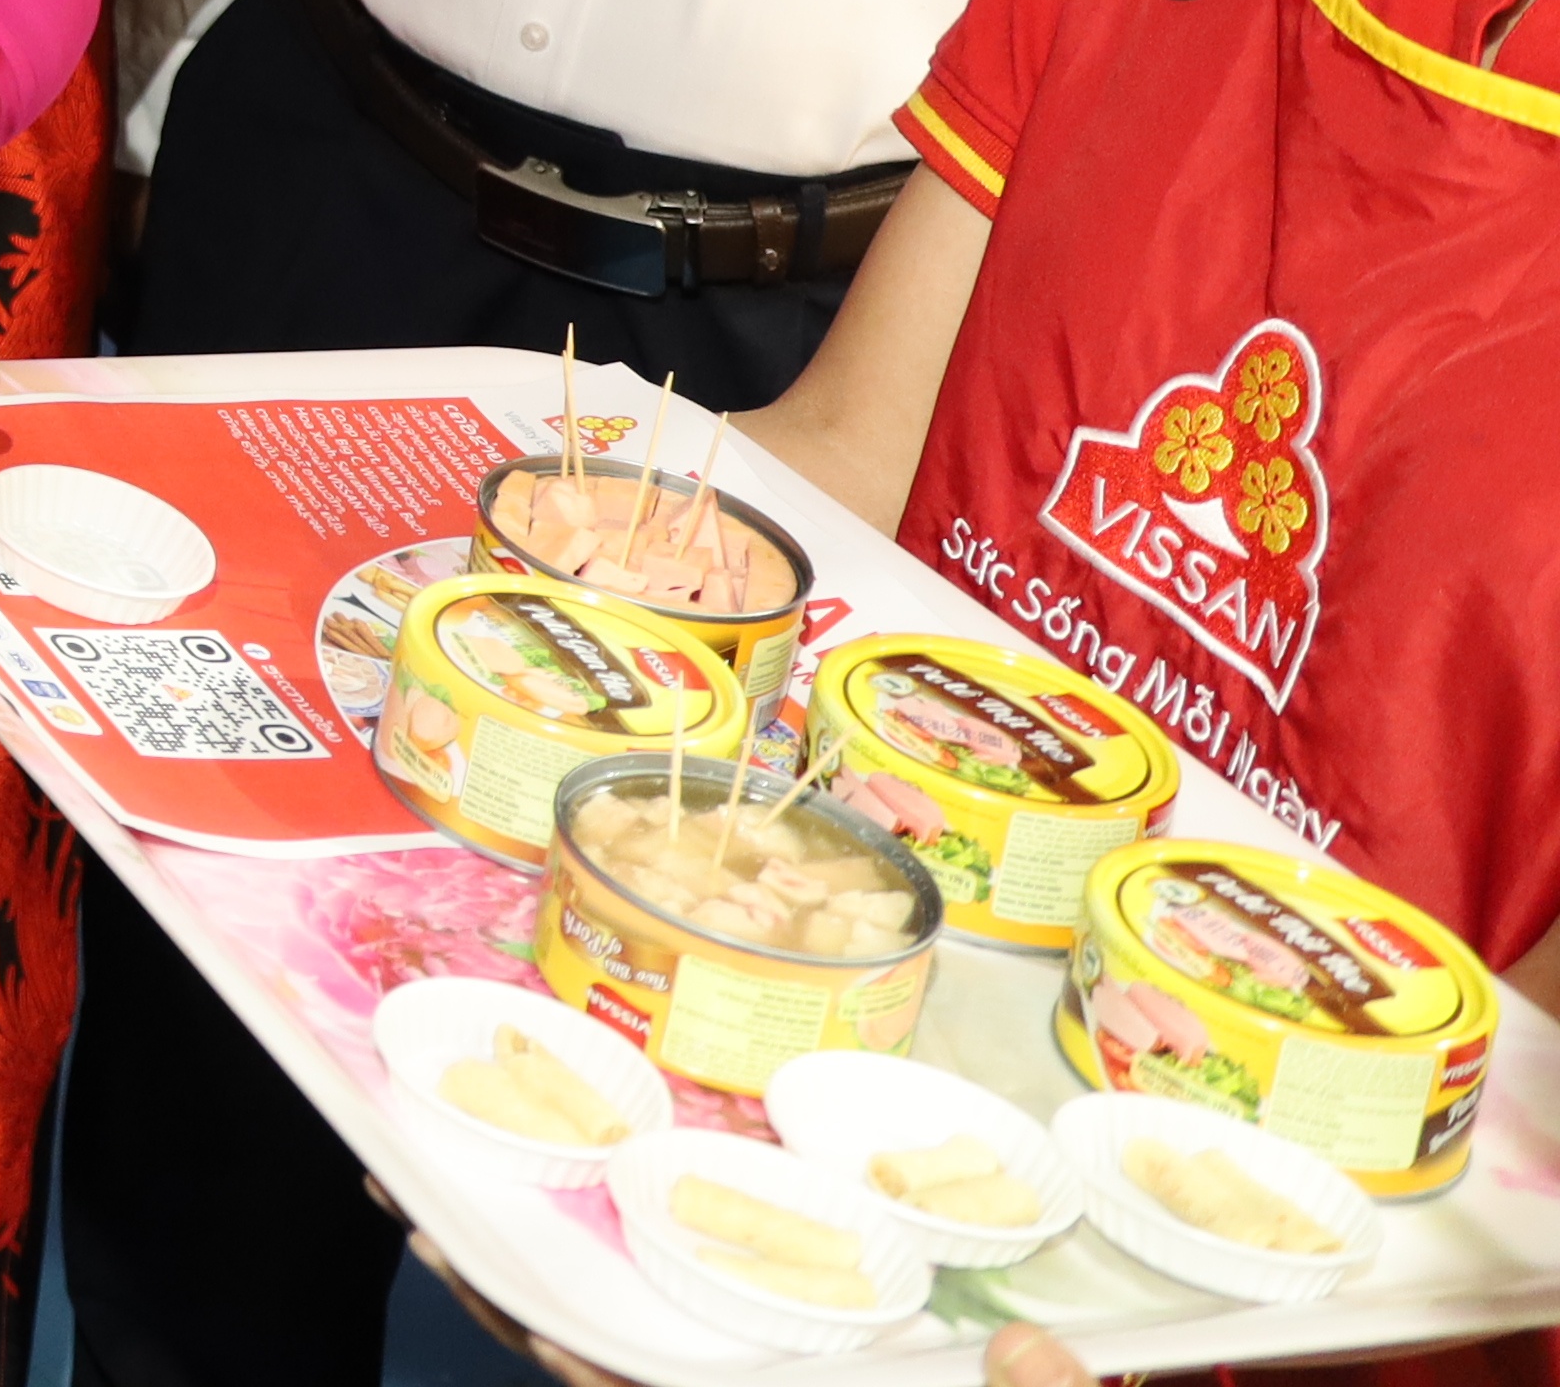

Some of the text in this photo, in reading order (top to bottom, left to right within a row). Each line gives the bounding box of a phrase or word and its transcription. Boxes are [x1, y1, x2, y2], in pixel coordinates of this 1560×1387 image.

[293, 406, 315, 430] Hoa
[334, 438, 355, 455] Big
[430, 434, 470, 471] VISSAN
[464, 452, 485, 466] 50
[327, 474, 367, 510] VISSAN
[377, 466, 404, 486] MM
[1089, 473, 1297, 669] VISSAN
[941, 516, 1016, 601] Sức
[1010, 577, 1138, 695] Sống
[1135, 657, 1232, 760] Mỗi
[1226, 729, 1342, 852] Ngày
[1039, 692, 1108, 741] VISSAN
[562, 909, 604, 958] Pork
[634, 970, 669, 993] Two
[584, 986, 653, 1037] VISSAN
